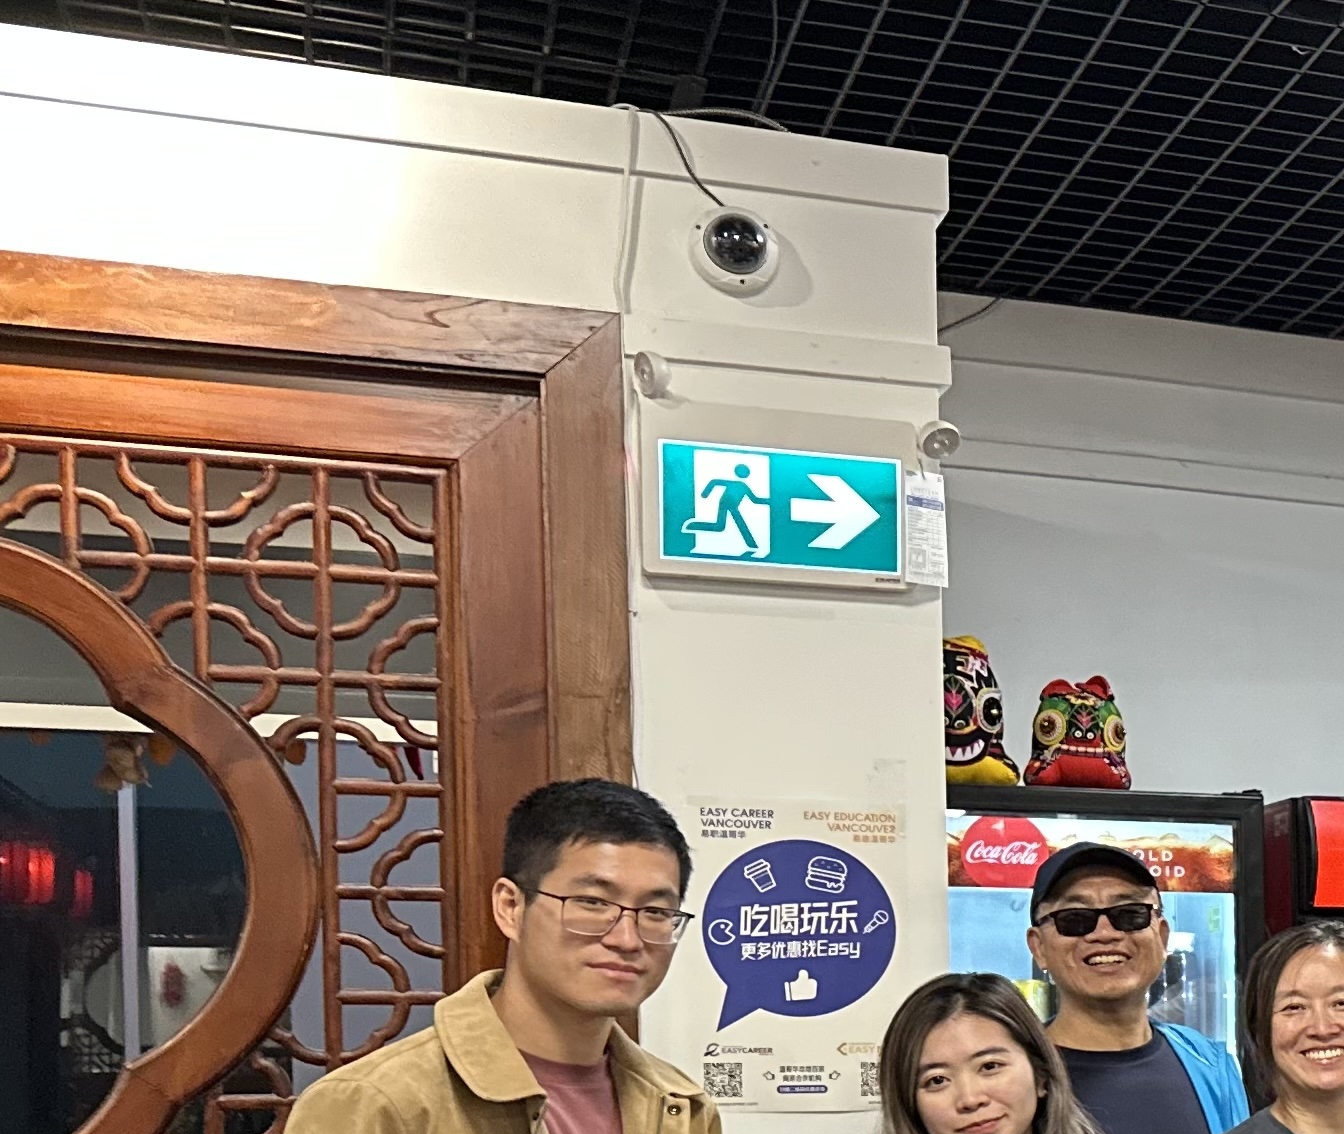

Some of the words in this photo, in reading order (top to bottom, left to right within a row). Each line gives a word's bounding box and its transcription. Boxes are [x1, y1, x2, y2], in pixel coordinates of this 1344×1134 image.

[700, 807, 728, 817] EASY
[731, 808, 774, 819] CAREER
[803, 810, 831, 821] EASY
[834, 811, 896, 823] EDUCATION
[701, 818, 772, 830] VANCOUVER
[827, 822, 896, 834] VANCOUVER
[966, 840, 1041, 865] Coca-Cola
[1132, 849, 1173, 862] OLD
[740, 900, 858, 937] 吃喝玩乐
[741, 940, 860, 960] 更多优惠找Easy
